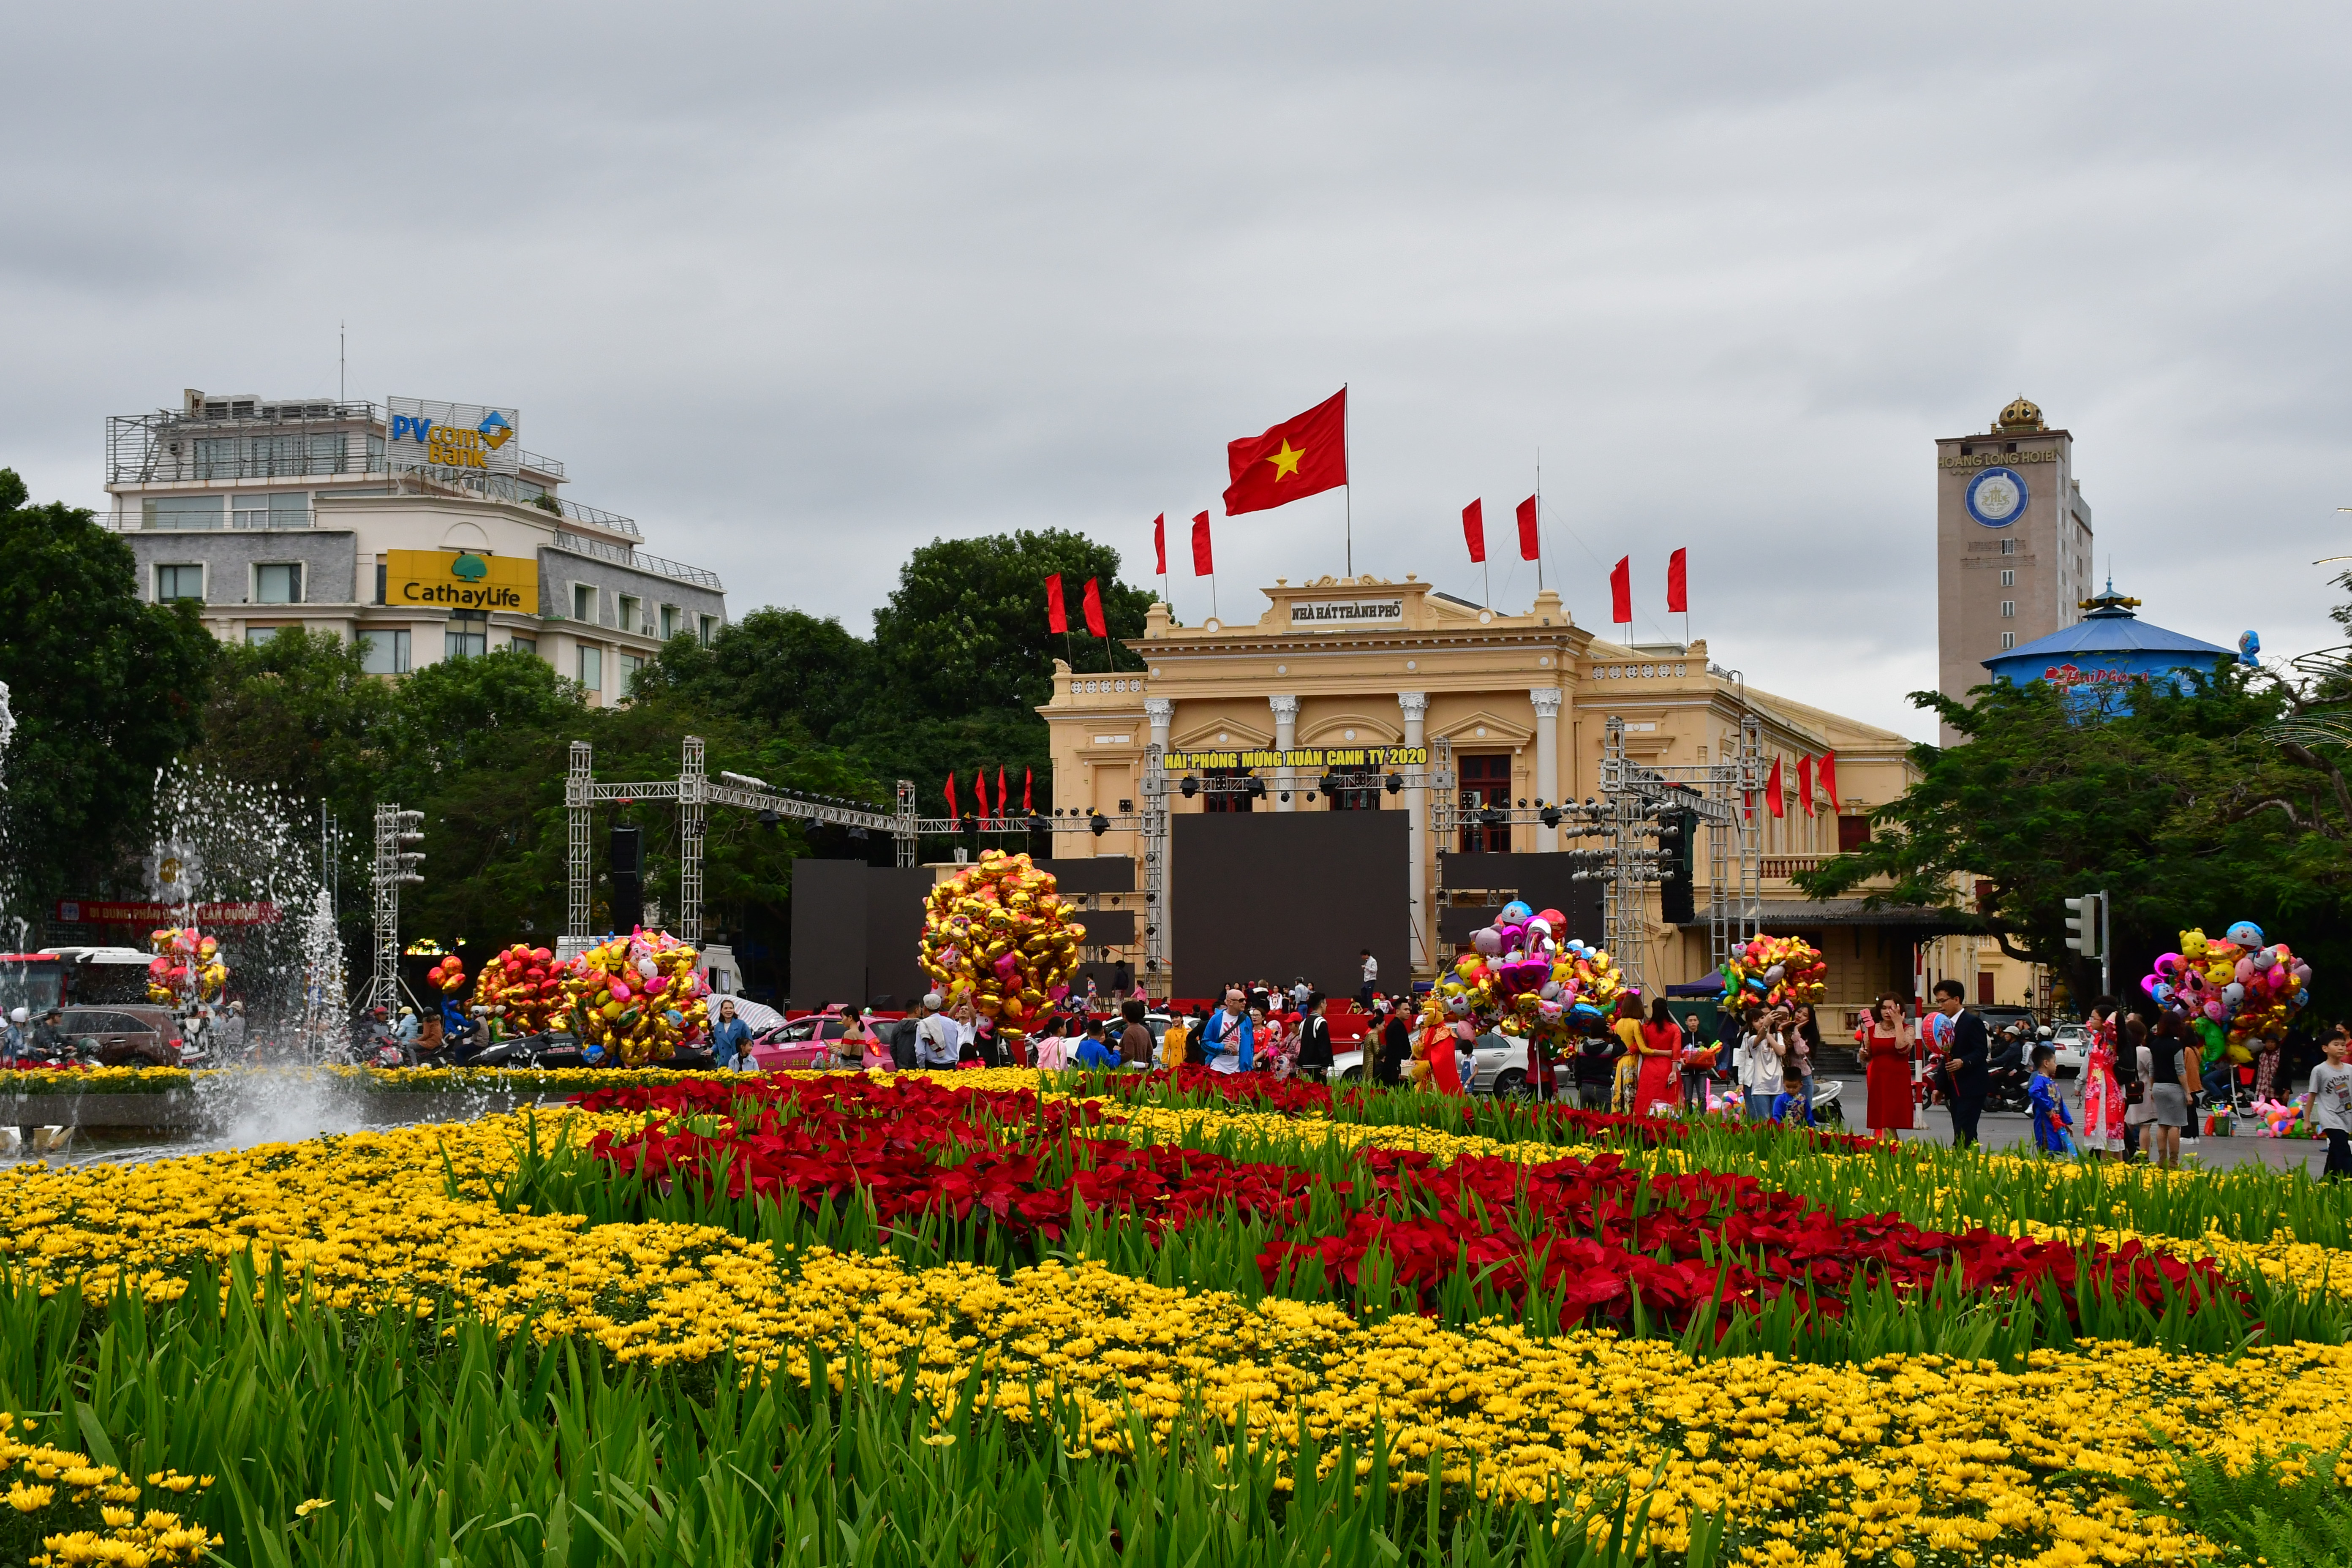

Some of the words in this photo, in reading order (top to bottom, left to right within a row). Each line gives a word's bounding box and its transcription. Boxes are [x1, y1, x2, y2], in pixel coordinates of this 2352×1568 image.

[428, 444, 488, 468] Bank
[1985, 453, 2019, 466] LONG
[2022, 451, 2057, 463] HOTEL
[1292, 604, 1315, 620] NHÀ
[1316, 603, 1338, 620] HÁT
[1339, 602, 1377, 619] THÀNH
[1378, 601, 1402, 618] PHỐ
[1164, 750, 1187, 769] HẢI
[1191, 750, 1238, 769] PHÒNG
[1241, 749, 1282, 768] MỪNG
[1285, 749, 1323, 767] XUÂN
[1326, 749, 1365, 766] CANH
[1368, 747, 1386, 765] TÝ
[1389, 748, 1427, 765] 2020
